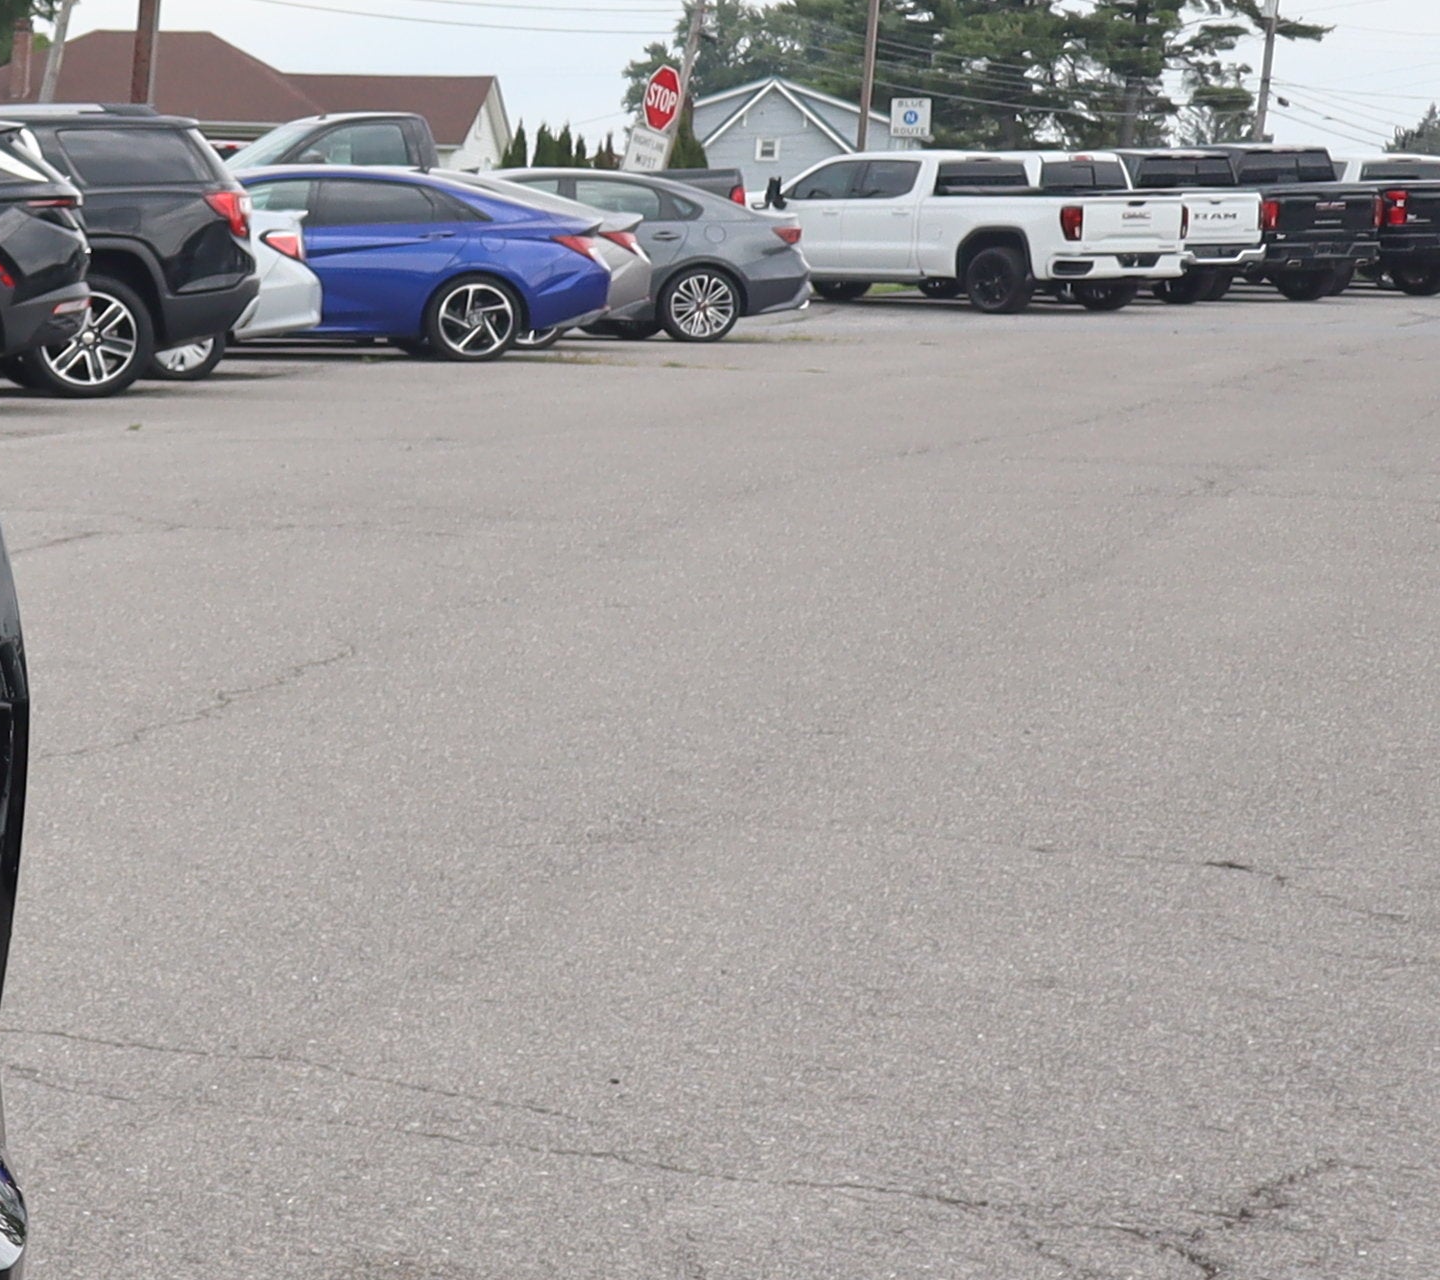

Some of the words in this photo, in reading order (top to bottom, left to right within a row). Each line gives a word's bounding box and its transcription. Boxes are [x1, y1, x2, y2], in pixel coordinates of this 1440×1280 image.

[646, 82, 677, 114] STOP
[897, 100, 925, 108] BLUE
[893, 127, 926, 135] ROUTE
[1194, 212, 1237, 220] RAM
